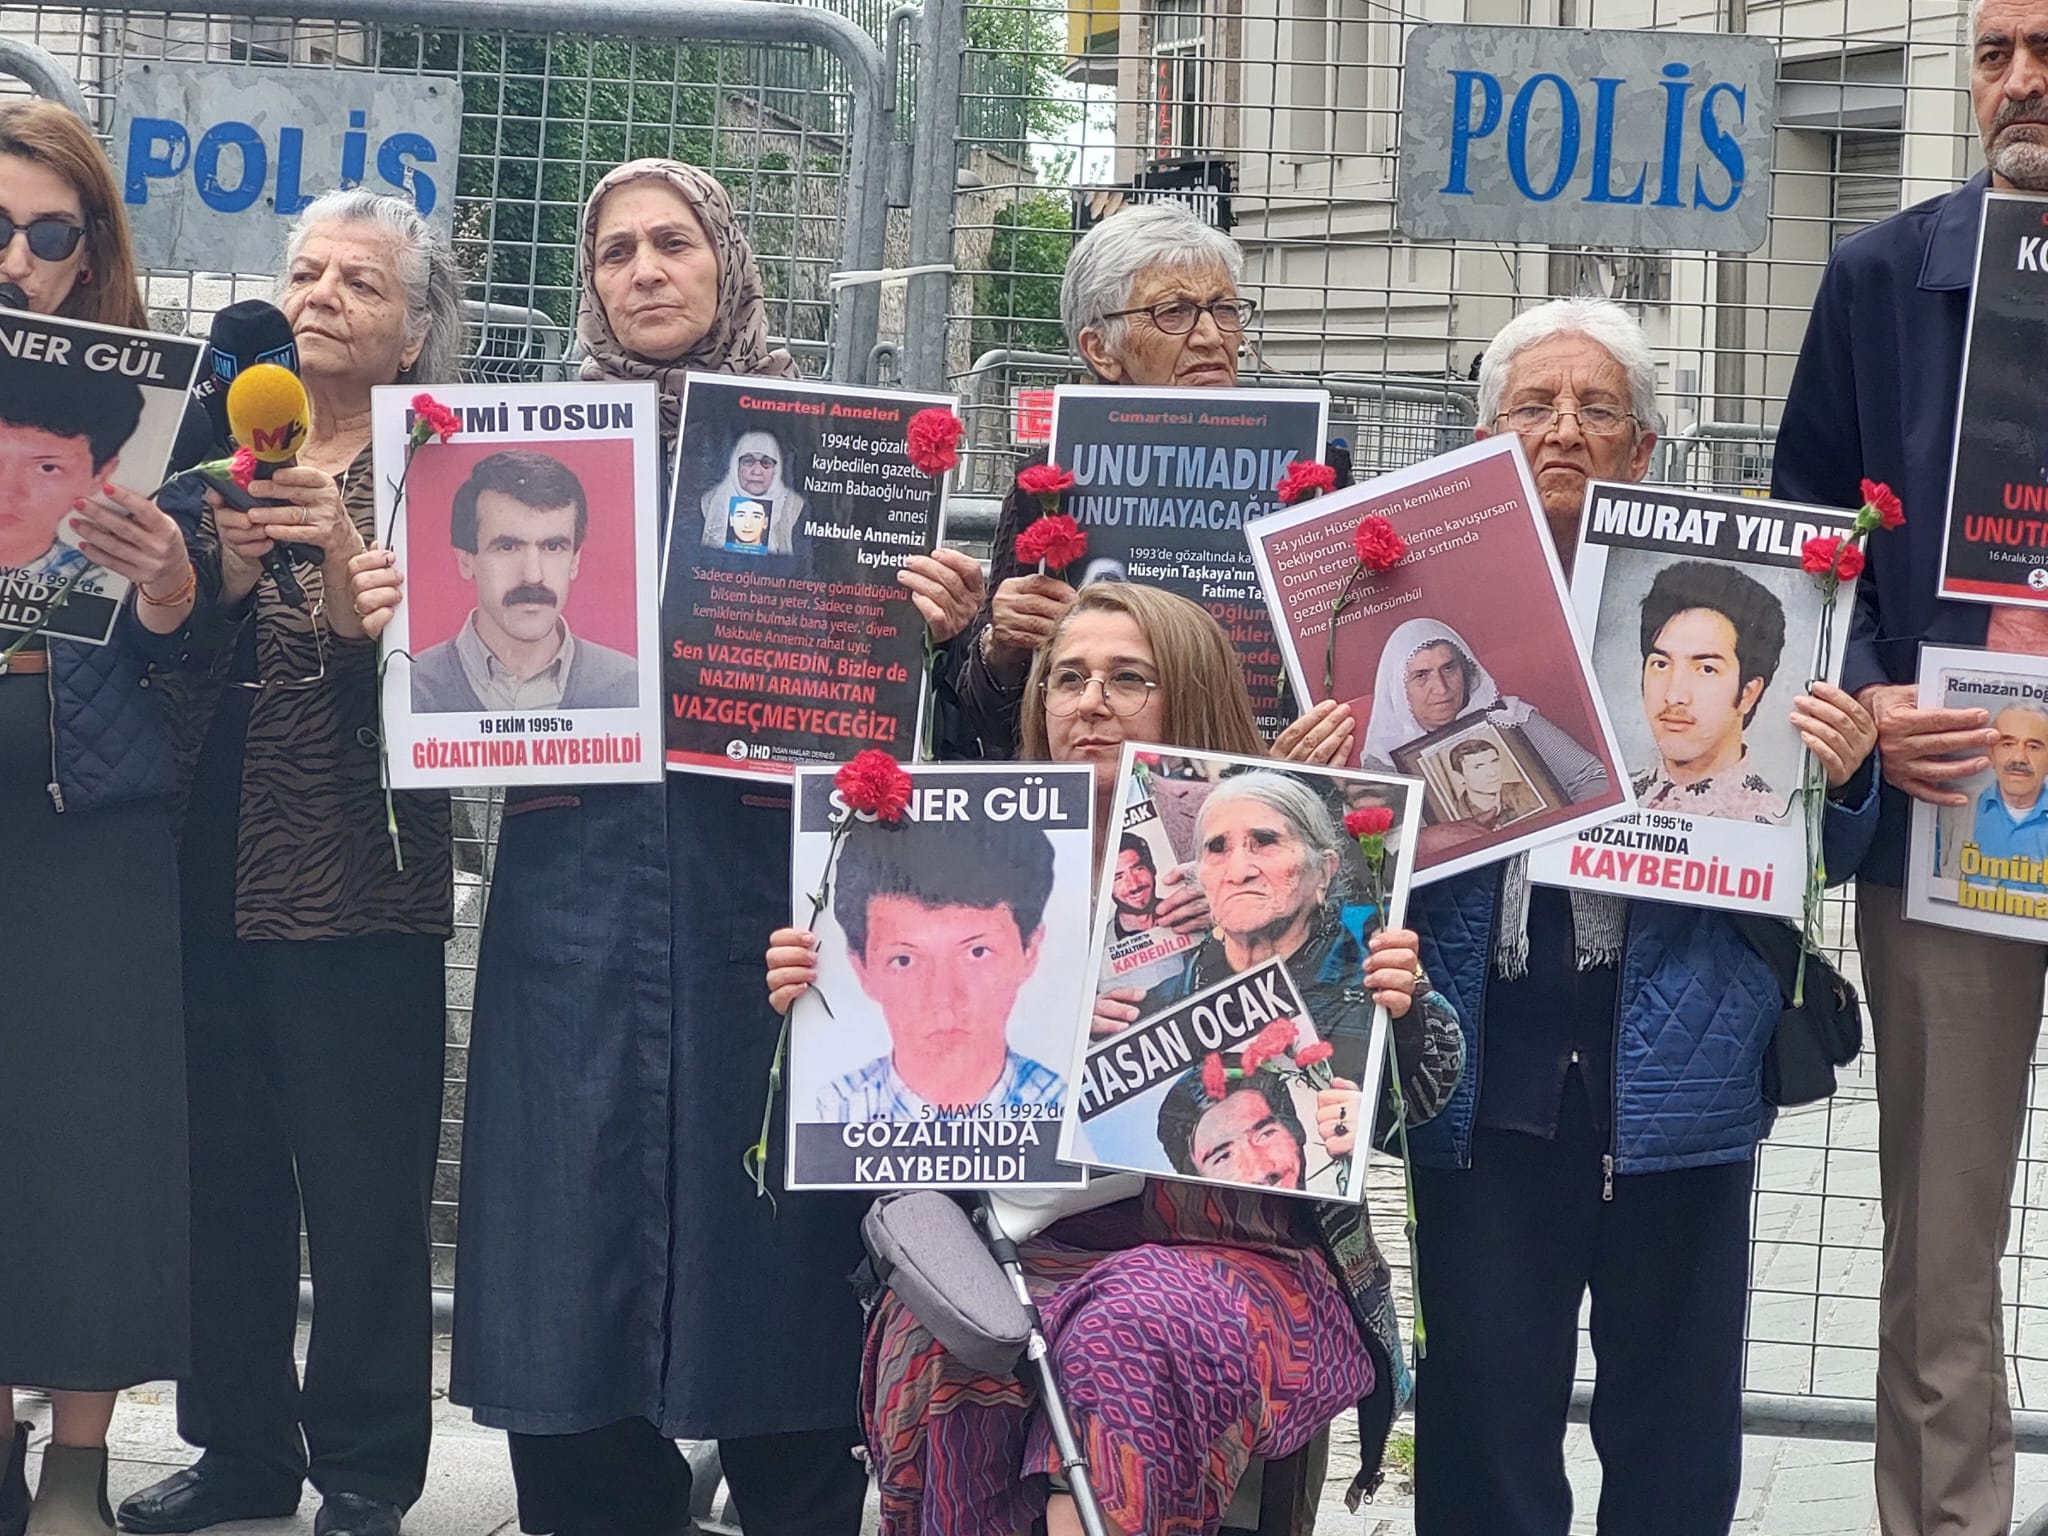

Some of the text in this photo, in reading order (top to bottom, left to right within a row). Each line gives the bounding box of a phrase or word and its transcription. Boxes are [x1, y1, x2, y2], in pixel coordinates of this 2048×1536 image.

[1439, 62, 1747, 213] POLİS
[124, 110, 437, 218] POLİS
[84, 339, 166, 380] GÜL
[517, 403, 633, 431] TOSUN
[739, 395, 900, 422] Cumartesi Anneleri
[1108, 410, 1267, 427] Cumartesi Anneleri
[821, 433, 909, 455] 1994'de gözalt
[812, 454, 879, 474] kaybedilen
[1073, 443, 1299, 491] UNUTMADIK
[804, 476, 930, 502] Nazım Babaoğlu'nun
[888, 510, 929, 524] annesi
[1272, 541, 1289, 555] 34
[1290, 530, 1324, 552] yıldır,
[1403, 477, 1472, 510] kemiklerini
[1593, 497, 1726, 546] MURAT
[804, 521, 926, 546] Makbule Annemizi
[1282, 569, 1318, 588] Onun
[1444, 499, 1519, 532] kavuşursam
[1428, 530, 1480, 557] sırtımda
[1130, 547, 1256, 566] 1993'de gözaltında ka
[1989, 551, 1999, 560] 16
[2001, 552, 2028, 564] Aralık
[37, 573, 104, 594] 199'de
[735, 571, 786, 588] oğlumun
[788, 579, 826, 595] nereye
[829, 581, 908, 602] gömüldüğünü
[1128, 562, 1254, 583] Hüseyin Taşkaya'nın
[710, 585, 747, 602] bilsem
[750, 590, 777, 606] bana
[813, 597, 852, 613] Sadece
[855, 604, 884, 617] onun
[1202, 583, 1246, 598] Fatime
[692, 602, 754, 622] kemiklerini
[756, 608, 798, 627] bulmak
[800, 613, 827, 630] bana
[866, 621, 897, 639] diyen
[1299, 621, 1327, 639] Anne
[1363, 587, 1423, 617] Morsümbül
[714, 624, 763, 641] Makbule
[764, 629, 814, 648] Annemiz
[816, 636, 845, 651] rahat
[672, 641, 908, 682] Sen VAZGEÇMEDİN, Bizler de
[699, 667, 876, 705] NAZIM'I ARAMAKTAN
[1948, 678, 2018, 697] Ramazan
[479, 716, 573, 734] 19 EKİM 1995'te
[672, 693, 897, 742] VAZGEÇMEYECEĞİZ!
[412, 732, 642, 769] GÖZALTINDA KAYBEDİLDİ
[983, 777, 1068, 821] GÜL
[1645, 813, 1693, 833] 1995'te
[1569, 845, 1774, 902] KAYBEDİLDİ
[1080, 970, 1295, 1113] HASAN OCAK
[920, 1105, 931, 1120] 5
[937, 1104, 993, 1120] MAYIS
[842, 1113, 1041, 1148] GÖZALTINDA
[855, 1146, 1026, 1182] KAYBEDİLDİ
